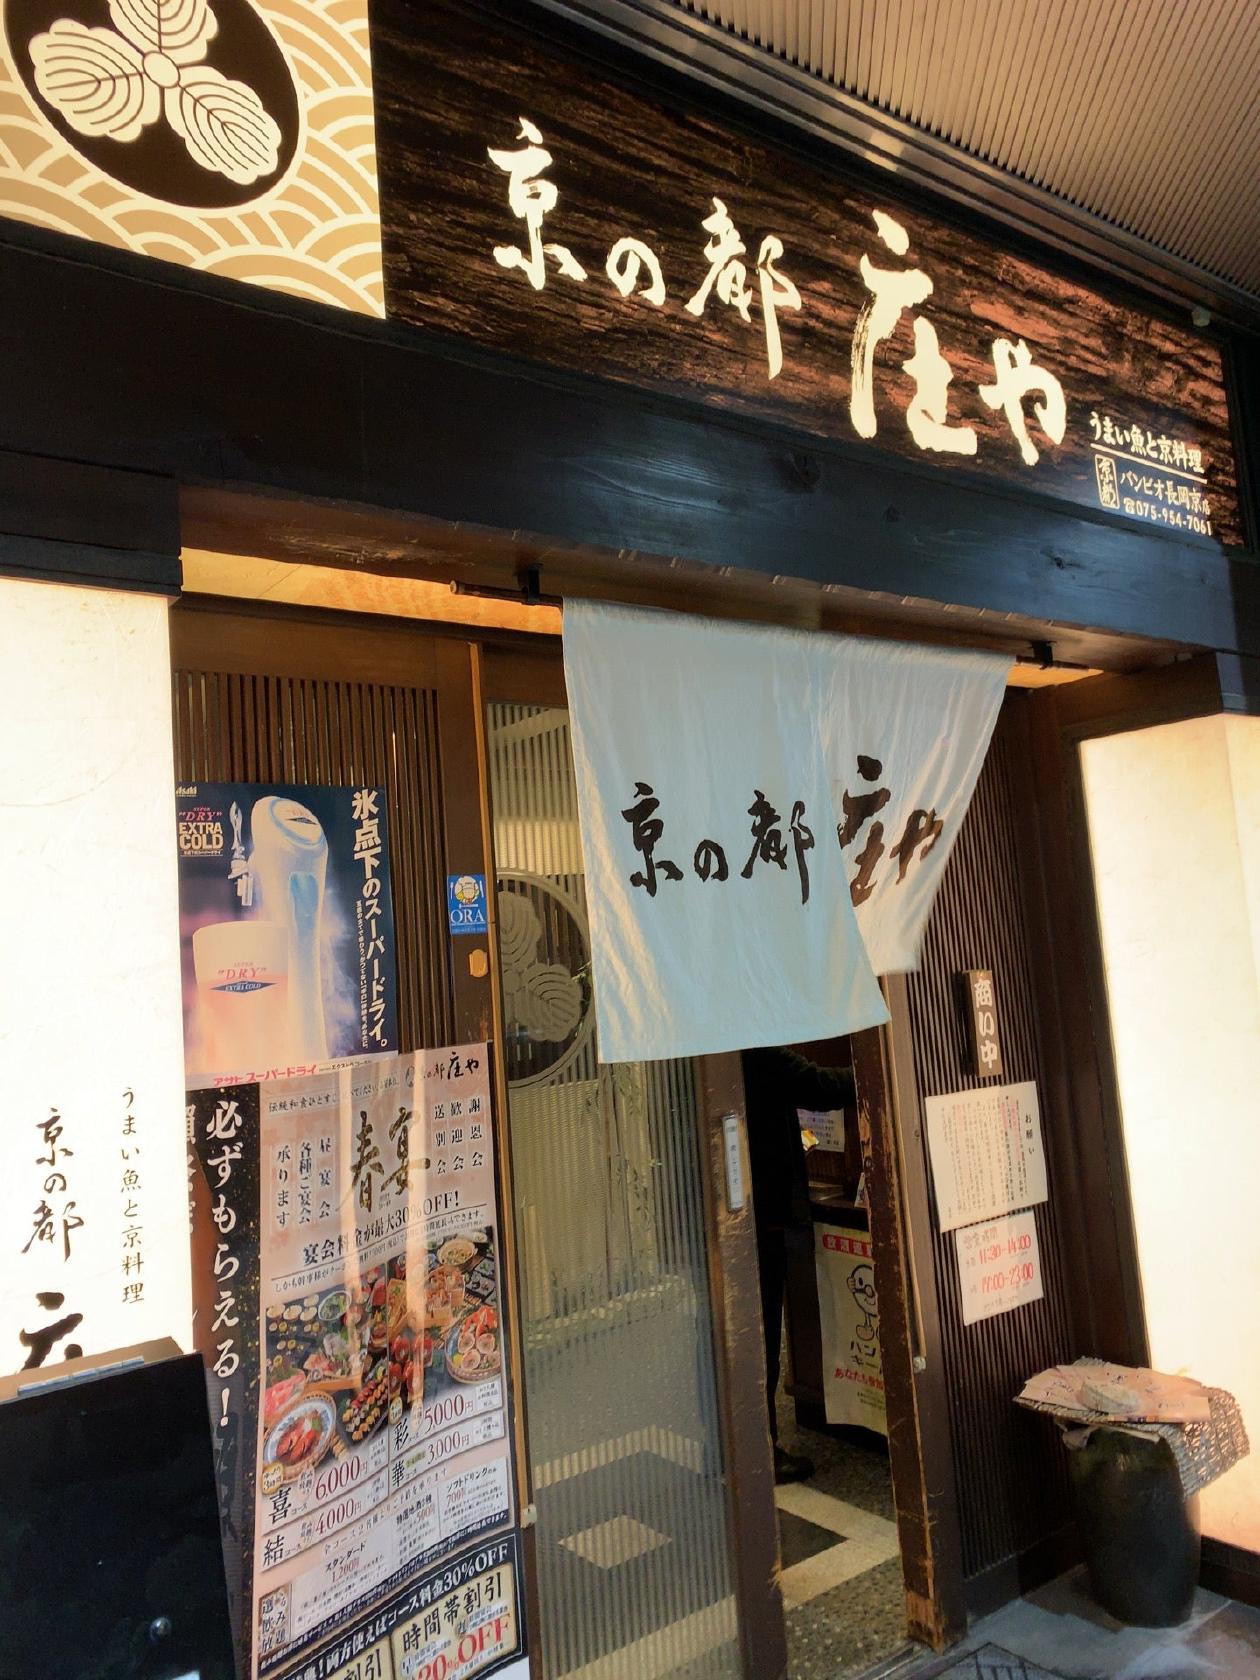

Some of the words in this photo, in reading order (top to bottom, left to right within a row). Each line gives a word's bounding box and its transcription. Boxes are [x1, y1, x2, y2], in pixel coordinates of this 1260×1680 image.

[1089, 411, 1205, 474] うまい魚と京料理
[1135, 500, 1212, 536] 075-954-7061
[179, 822, 223, 834] EXTRA
[180, 834, 224, 850] COLD
[351, 789, 388, 1048] 氷点下のスーパードライ。
[974, 977, 998, 1069] 商い中
[120, 1086, 145, 1304] うまい魚と京料理
[402, 1572, 502, 1653] 時間帯割引
